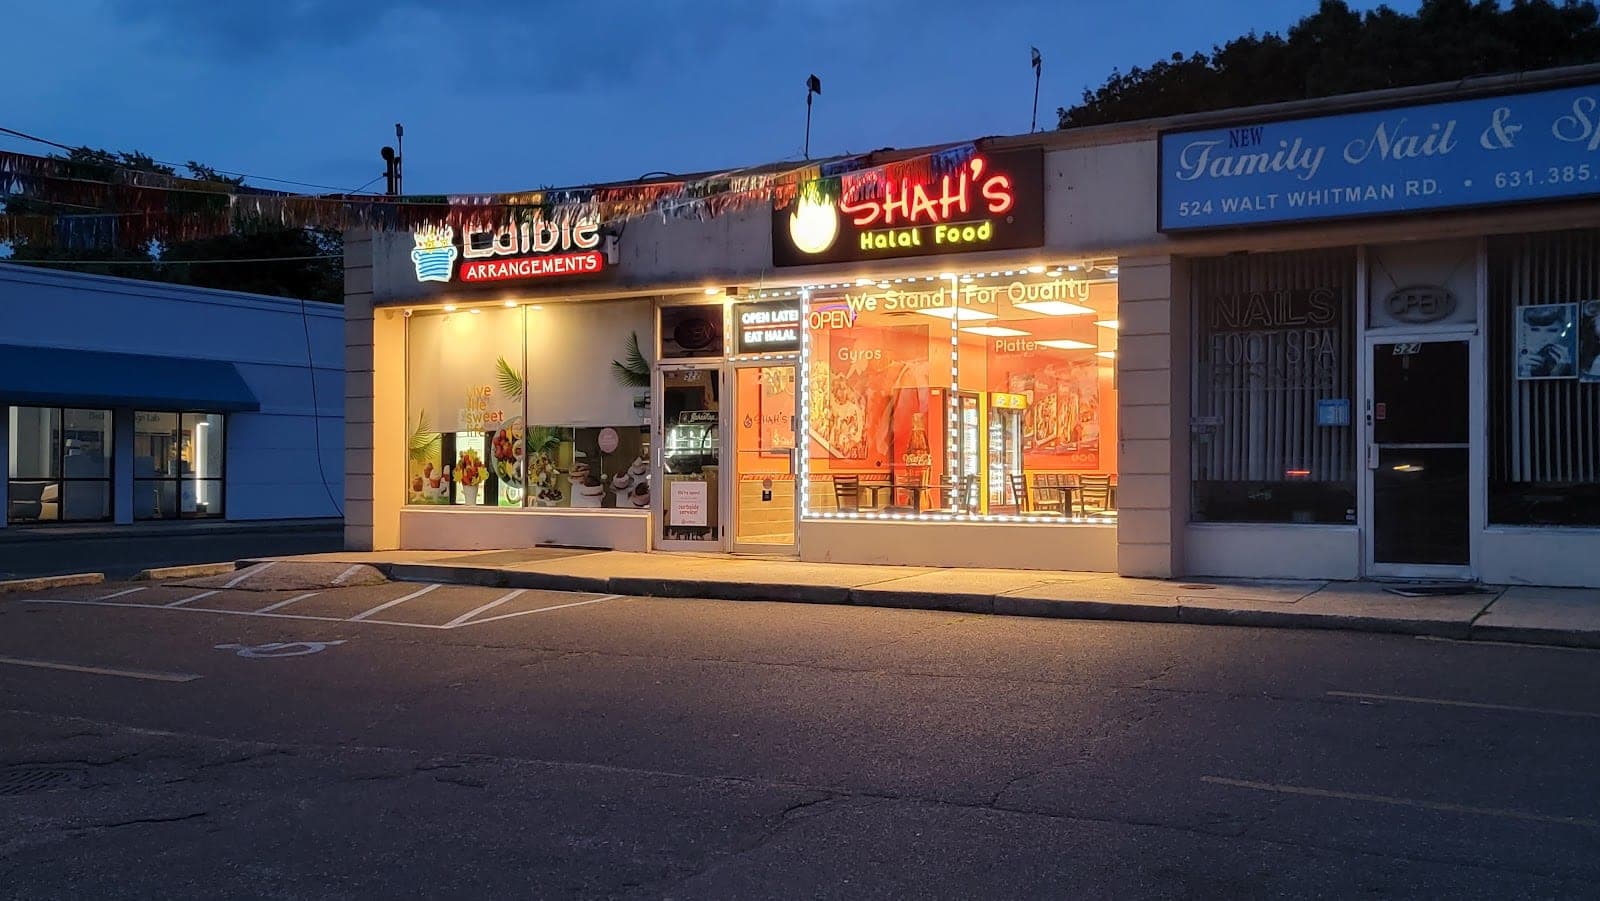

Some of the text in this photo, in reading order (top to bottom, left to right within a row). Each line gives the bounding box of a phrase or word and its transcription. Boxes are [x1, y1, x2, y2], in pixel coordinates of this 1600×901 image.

[1176, 137, 1326, 181] Family
[1343, 119, 1458, 165] Nail
[1480, 107, 1523, 149] &
[1228, 127, 1264, 149] NEW
[840, 157, 1013, 226] SHAH'S
[1179, 200, 1214, 217] 524
[1221, 194, 1279, 214] WALT
[1287, 184, 1395, 208] WHITMAN
[1406, 179, 1443, 197] RD.
[860, 221, 994, 250] Halal Food
[466, 254, 598, 280] ARRANGEMENTS
[845, 279, 1091, 313] We Stand For Quality
[1208, 288, 1337, 328] NAILS
[741, 311, 769, 324] OPEN
[809, 309, 854, 330] OPEN
[744, 330, 798, 343] EAT HALAL
[1286, 329, 1337, 364] SPA
[838, 346, 882, 362] Gyros
[466, 410, 504, 424] sweet
